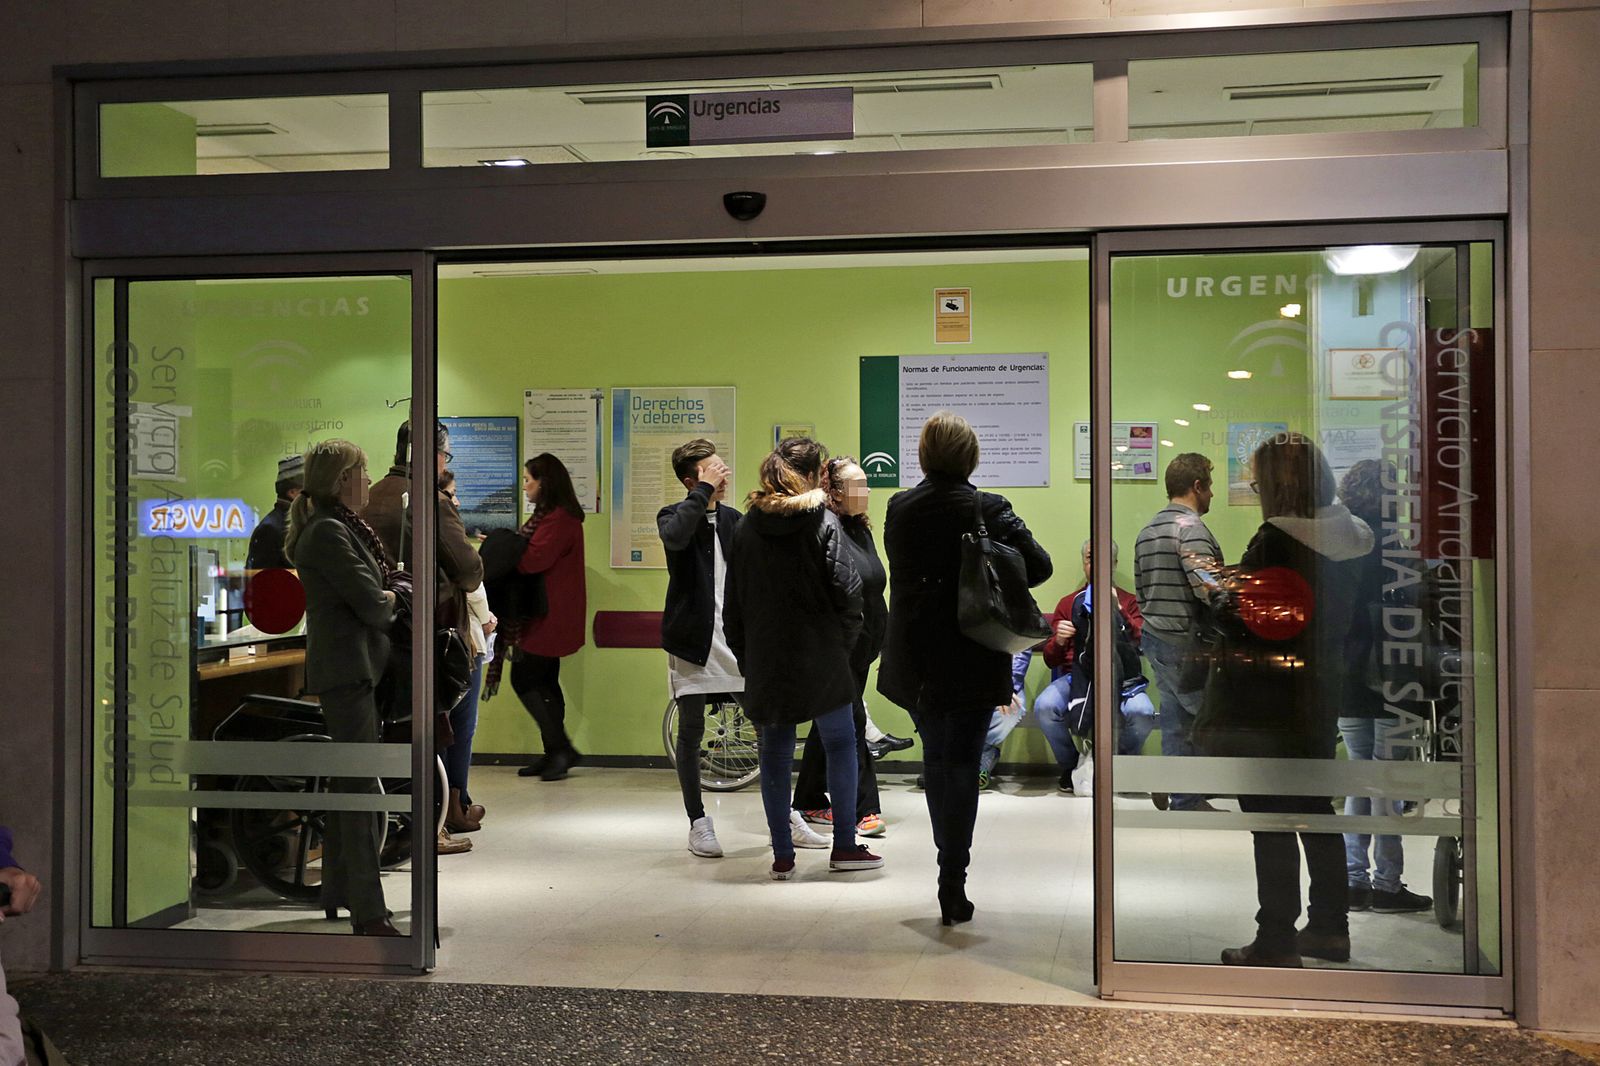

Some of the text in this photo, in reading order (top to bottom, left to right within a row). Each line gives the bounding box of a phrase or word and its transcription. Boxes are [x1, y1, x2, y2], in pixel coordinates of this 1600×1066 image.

[693, 98, 781, 119] Urgencias
[942, 365, 996, 373] Funcionamiento
[1009, 364, 1045, 373] Urgencias:
[150, 345, 185, 475] Servicio
[632, 411, 705, 424] y deberes
[633, 396, 704, 411] Derechos
[1436, 327, 1478, 469] Servicio
[1274, 432, 1312, 446] DEL
[1380, 321, 1422, 593] CONSEJERIA
[103, 340, 139, 787] CONSEJERIA DE SALUD
[1436, 480, 1480, 643] Andaluz
[150, 639, 183, 681] de
[1380, 607, 1423, 667] DE
[1438, 655, 1481, 702] de
[150, 694, 184, 786] Salud
